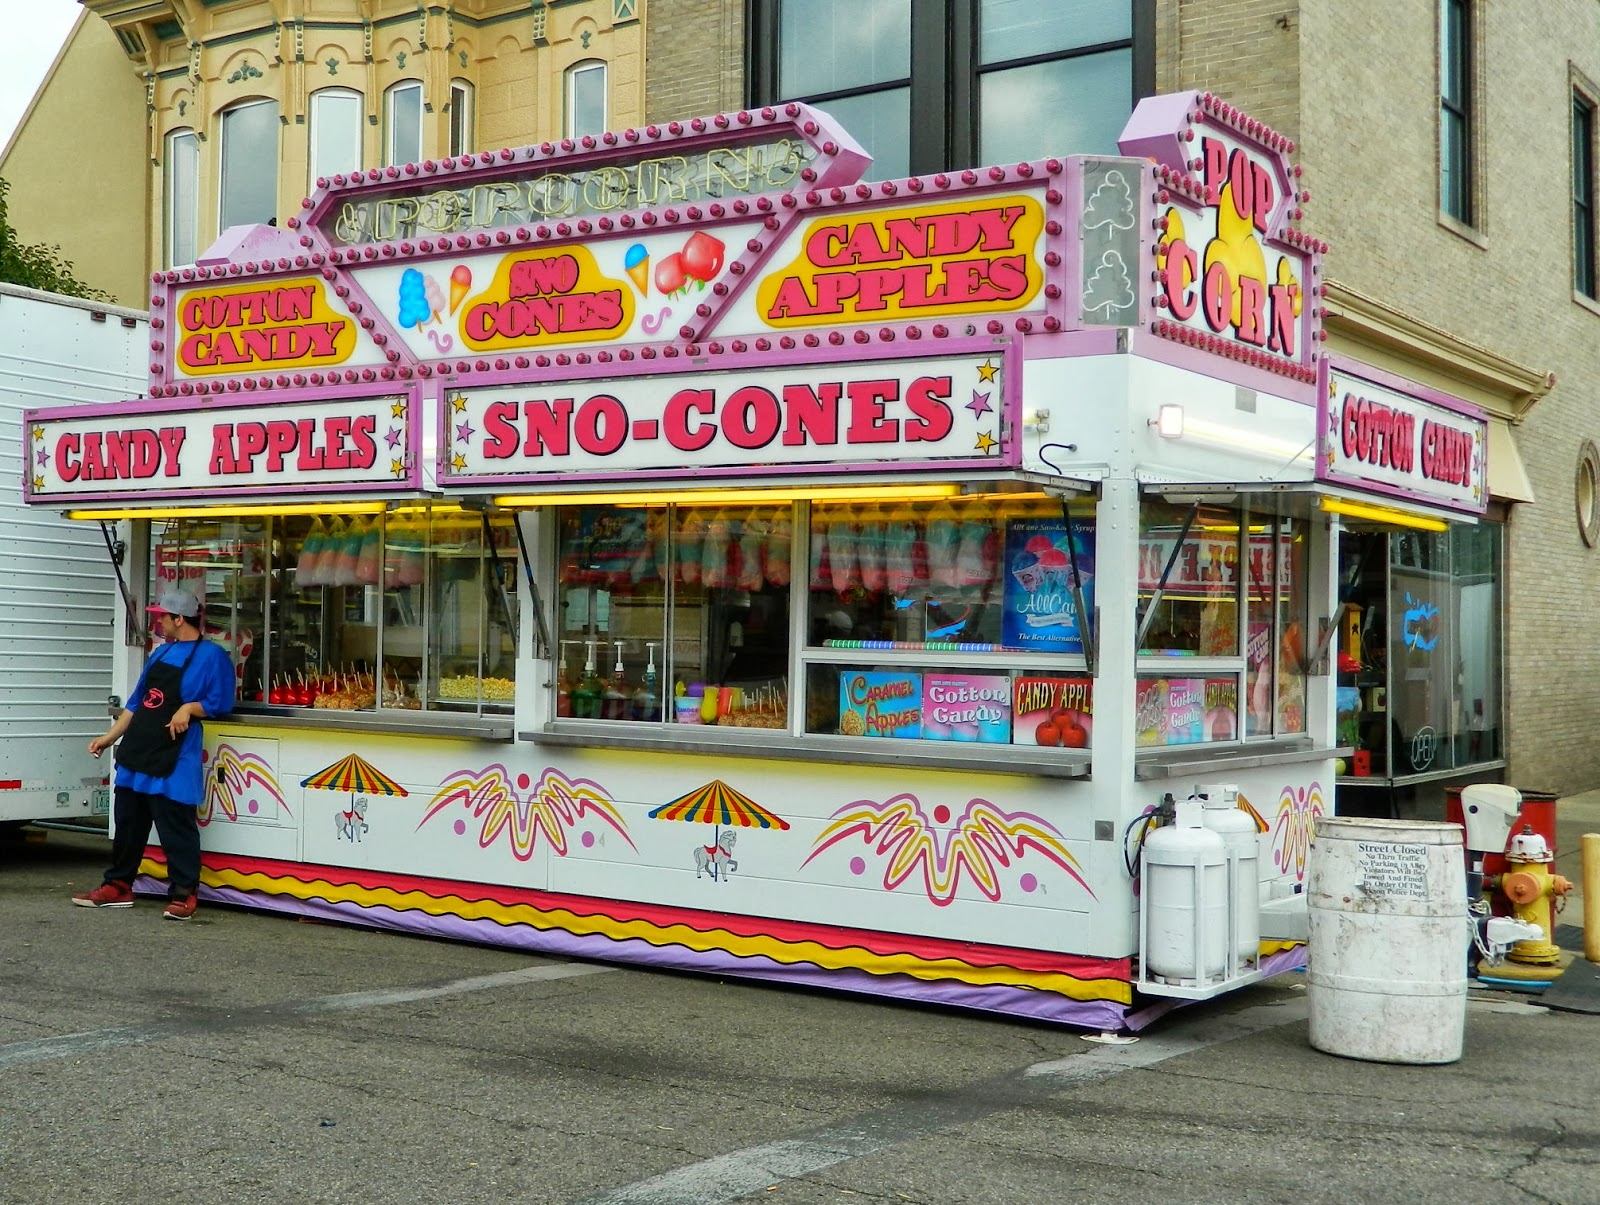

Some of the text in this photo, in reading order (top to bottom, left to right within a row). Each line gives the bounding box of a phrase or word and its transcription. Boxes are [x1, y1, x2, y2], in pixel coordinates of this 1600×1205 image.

[374, 146, 752, 240] POPCORN
[1201, 136, 1274, 235] POP
[806, 205, 1025, 269] CANDY
[508, 254, 580, 299] SNO
[768, 255, 1029, 319] APPLES
[182, 286, 316, 332] COTTON
[1165, 238, 1298, 357] CORN
[465, 288, 623, 342] CONES
[180, 321, 346, 368] CANDY
[482, 375, 955, 460] SNO-CONES
[55, 415, 378, 483] CANDY APPLES
[1342, 392, 1473, 488] COTTON CANDY
[1018, 632, 1031, 641] The
[1032, 633, 1046, 642] Best
[850, 676, 914, 705] CARAMEL
[929, 684, 1010, 707] Cotton
[1017, 681, 1058, 716] CANDY
[865, 702, 921, 736] APPLES
[933, 705, 1002, 726] Candy
[1411, 733, 1436, 763] OPEN
[1358, 843, 1427, 855] Street Closed
[1371, 860, 1398, 868] Parking
[1377, 853, 1395, 861] Thru
[1397, 854, 1421, 862] Traffic
[1363, 873, 1385, 881] Towed
[1403, 875, 1423, 883] Fined
[1374, 880, 1396, 888] Order
[1396, 867, 1411, 875] Will
[1387, 888, 1408, 896] Police
